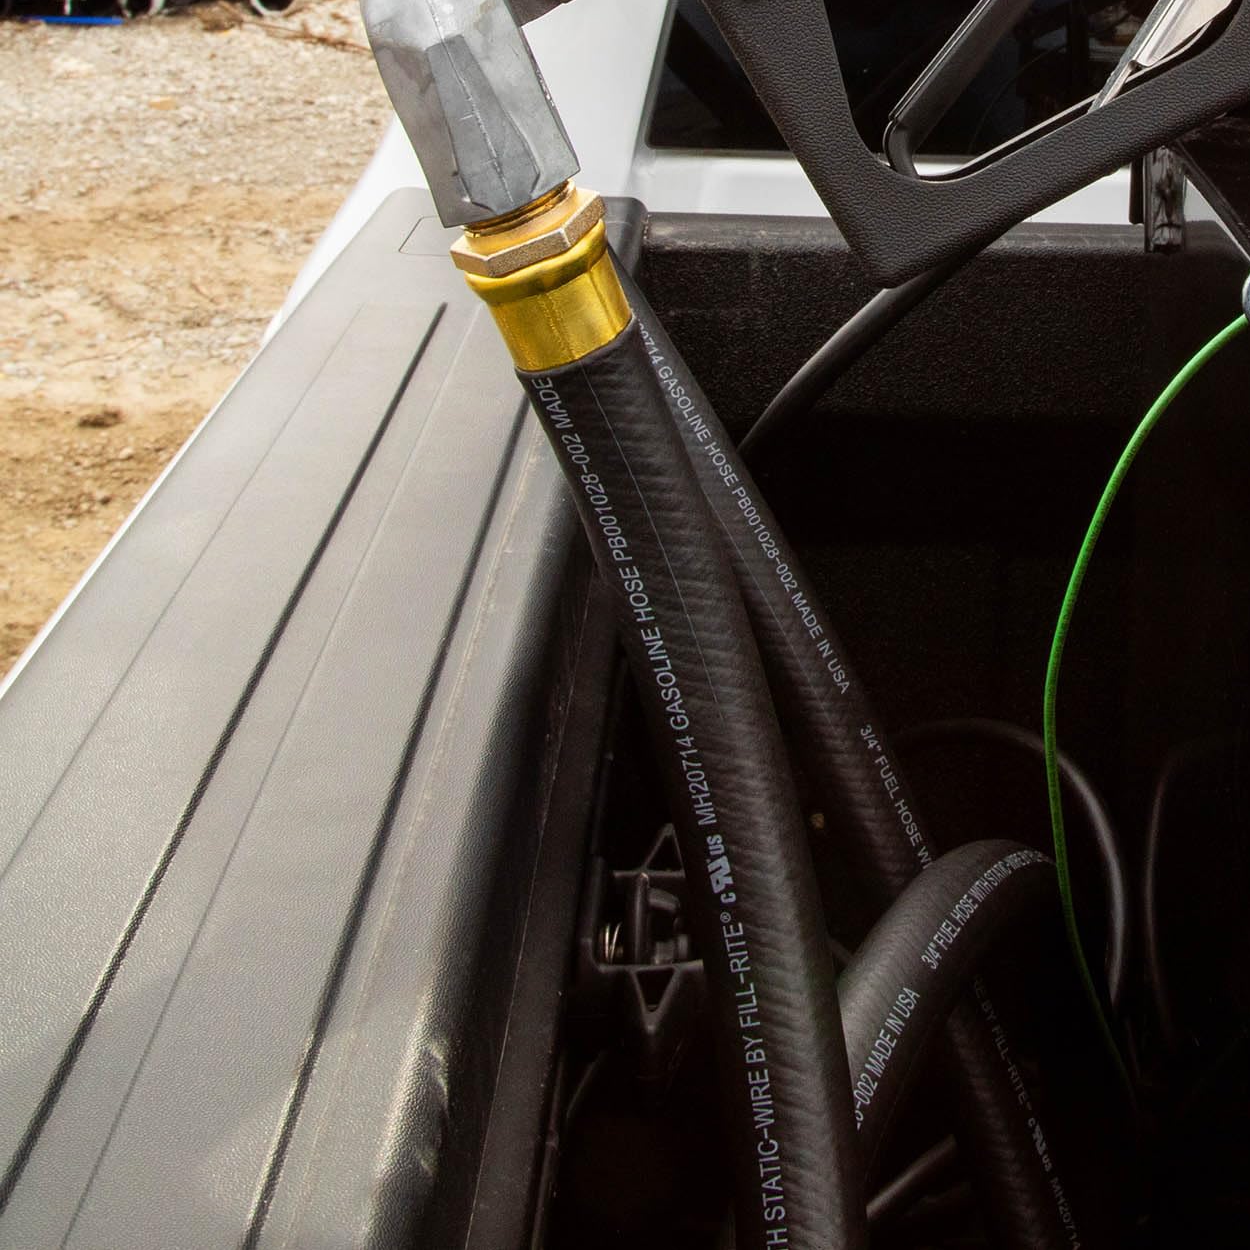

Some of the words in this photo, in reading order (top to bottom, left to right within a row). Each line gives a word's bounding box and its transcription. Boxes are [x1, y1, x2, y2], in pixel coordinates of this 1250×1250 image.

[532, 376, 573, 430] MADE
[561, 432, 633, 562] PB001028-002
[658, 366, 712, 442] GASOLINE
[705, 441, 739, 488] HOSE
[732, 486, 798, 591] PB001028-002
[792, 592, 823, 639] MADE
[816, 638, 833, 659] IN
[827, 657, 850, 695] USA
[619, 565, 656, 623] HOSE
[641, 626, 690, 731] GASOLINE
[676, 735, 717, 826] MH20714
[860, 723, 883, 750] 3/4"
[874, 753, 898, 799] FUEL
[895, 798, 922, 846] HOSE
[921, 942, 942, 970] 3/4"
[933, 919, 961, 950] FUEL
[950, 894, 979, 926] HOSE
[968, 877, 994, 903] WITH
[885, 1012, 905, 1035] IN
[893, 987, 920, 1019] USA
[742, 1035, 767, 1064] BY
[865, 1029, 897, 1078] MADE
[748, 1068, 786, 1221] STATIC-WIRE
